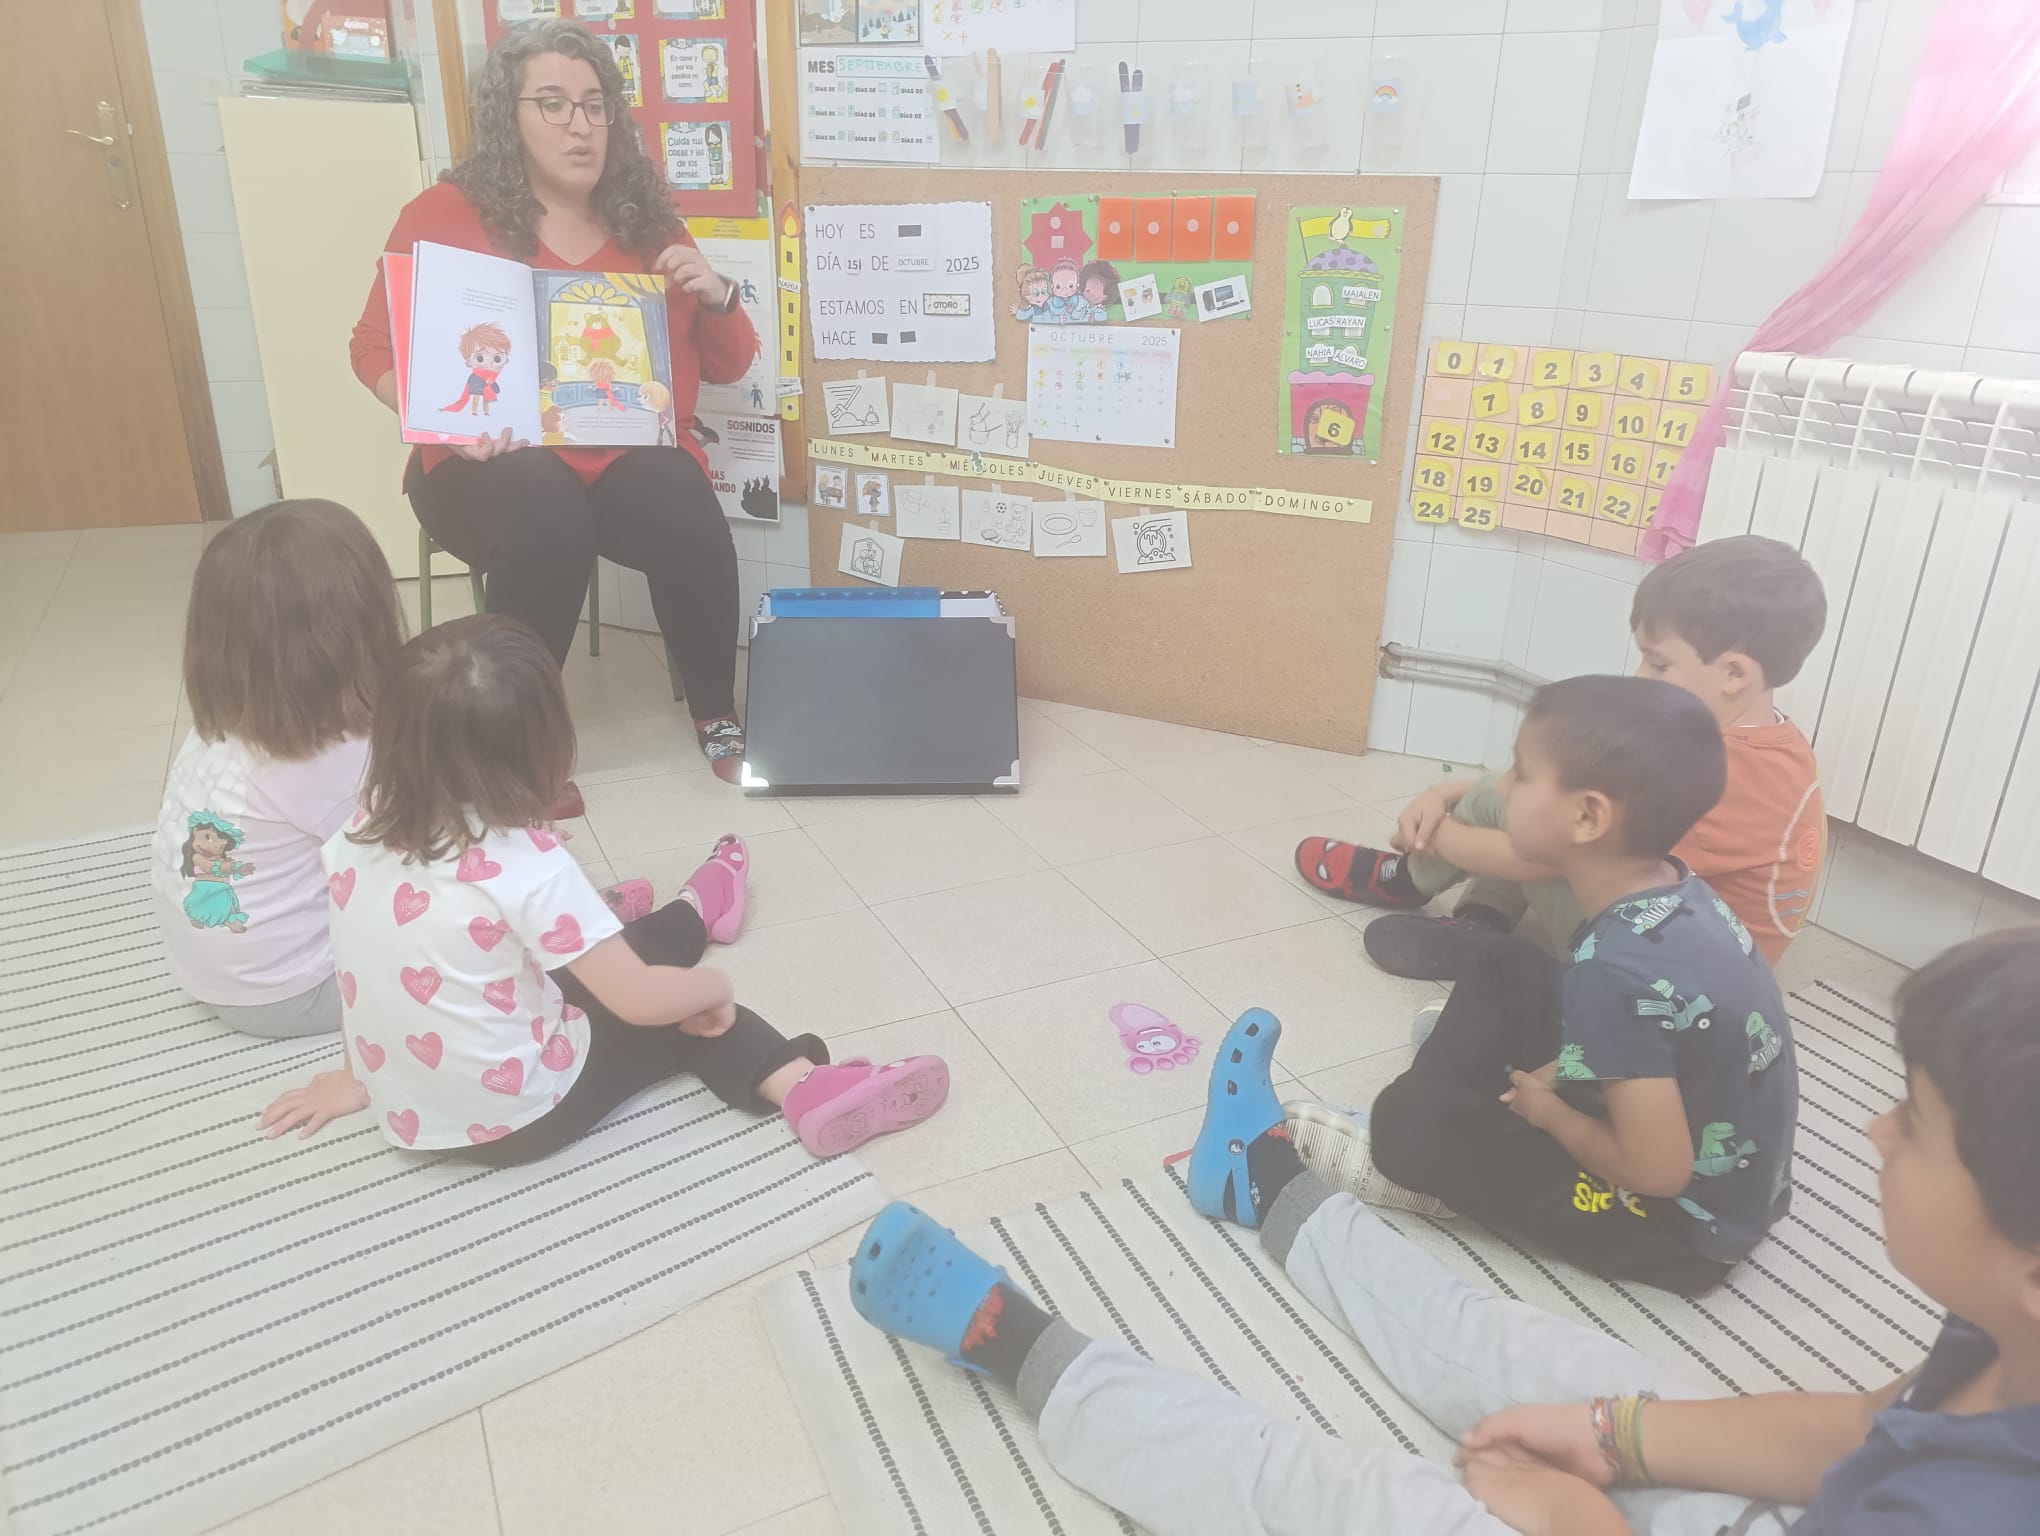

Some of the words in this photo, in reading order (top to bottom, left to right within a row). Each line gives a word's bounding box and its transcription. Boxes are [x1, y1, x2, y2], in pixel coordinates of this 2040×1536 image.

[807, 60, 836, 74] MES
[838, 57, 923, 73] SEPTIEMBRE
[667, 137, 690, 146] Cuida
[815, 223, 844, 239] HOY
[859, 223, 876, 239] ES
[816, 252, 841, 271] DÍA
[871, 255, 889, 271] DE
[898, 258, 929, 267] OCTUBRE
[946, 256, 980, 273] 2025
[779, 279, 799, 291] NAHIA
[1343, 288, 1380, 300] MAIALEN
[820, 299, 885, 315] ESTAMOS
[900, 299, 918, 315] EN
[1309, 317, 1334, 328] LUCAS
[1336, 317, 1363, 327] RAYAN
[822, 330, 856, 346] HACE
[1050, 331, 1115, 344] OCTUBRE
[1142, 335, 1168, 346] 2025
[1307, 348, 1332, 357] NAHIA
[1448, 352, 1461, 369] 0
[1493, 358, 1504, 374] 1
[1544, 362, 1558, 380] 2
[1588, 364, 1602, 382] 3
[1630, 372, 1645, 390] 4
[1679, 376, 1694, 396] 5
[1483, 394, 1496, 412] 7
[1531, 402, 1544, 419] 8
[1576, 404, 1589, 422] 9
[727, 419, 776, 434] SOSNIDOS
[1328, 423, 1341, 438] 6
[1618, 415, 1644, 434] 10
[1663, 420, 1688, 441] 11
[1431, 432, 1456, 451] 12
[1475, 433, 1500, 453] 13
[1519, 441, 1547, 459] 14
[1564, 442, 1590, 460] 15
[1611, 454, 1637, 475] 16
[813, 443, 854, 458] LUNES
[871, 452, 924, 466] MARTES
[1038, 469, 1092, 490] JUEVES
[1108, 486, 1172, 500] VIERNES
[1183, 490, 1247, 504] SÁBADO
[1265, 495, 1345, 514] DOMINGO
[1420, 468, 1446, 488] 18
[1466, 475, 1493, 493] 19
[1515, 474, 1544, 496] 20
[711, 481, 737, 494] ANDO
[1560, 488, 1586, 509] 21
[1602, 495, 1632, 519] 22
[1417, 501, 1444, 519] 24
[1463, 506, 1491, 526] 25
